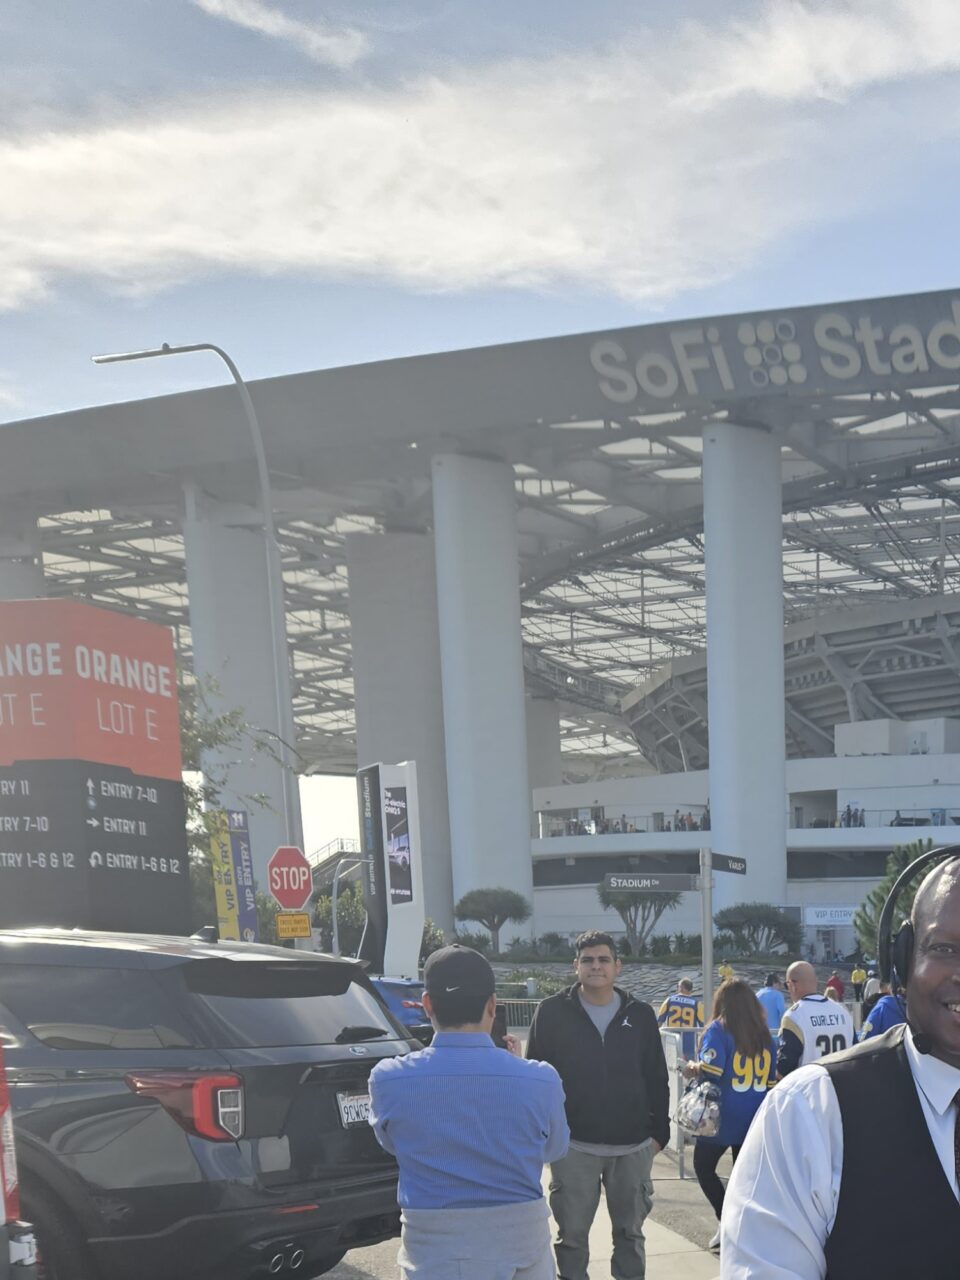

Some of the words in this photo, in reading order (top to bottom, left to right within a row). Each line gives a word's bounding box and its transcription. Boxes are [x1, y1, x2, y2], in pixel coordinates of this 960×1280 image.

[589, 327, 735, 401] SoFi
[75, 645, 173, 698] ORANGE
[30, 693, 46, 726] E
[96, 697, 136, 736] LOT
[145, 708, 161, 742] E
[20, 779, 30, 795] 11
[101, 780, 134, 799] ENTRY
[136, 785, 159, 804] 7-10
[23, 816, 50, 832] 7-10
[103, 816, 136, 835] ENTRY
[138, 820, 148, 836] 11
[0, 853, 23, 868] TRY
[27, 852, 47, 868] 1-6
[62, 852, 76, 868] 12
[106, 852, 139, 870] ENTRY
[141, 856, 157, 872] 1-6
[169, 858, 181, 874] 12
[241, 841, 252, 885] ENTRY
[271, 866, 309, 890] STOP
[610, 877, 651, 888] STADIUM
[245, 889, 255, 911] VIP
[668, 1005, 694, 1027] 29
[810, 1014, 839, 1027] GURLEY
[731, 1048, 772, 1093] 99
